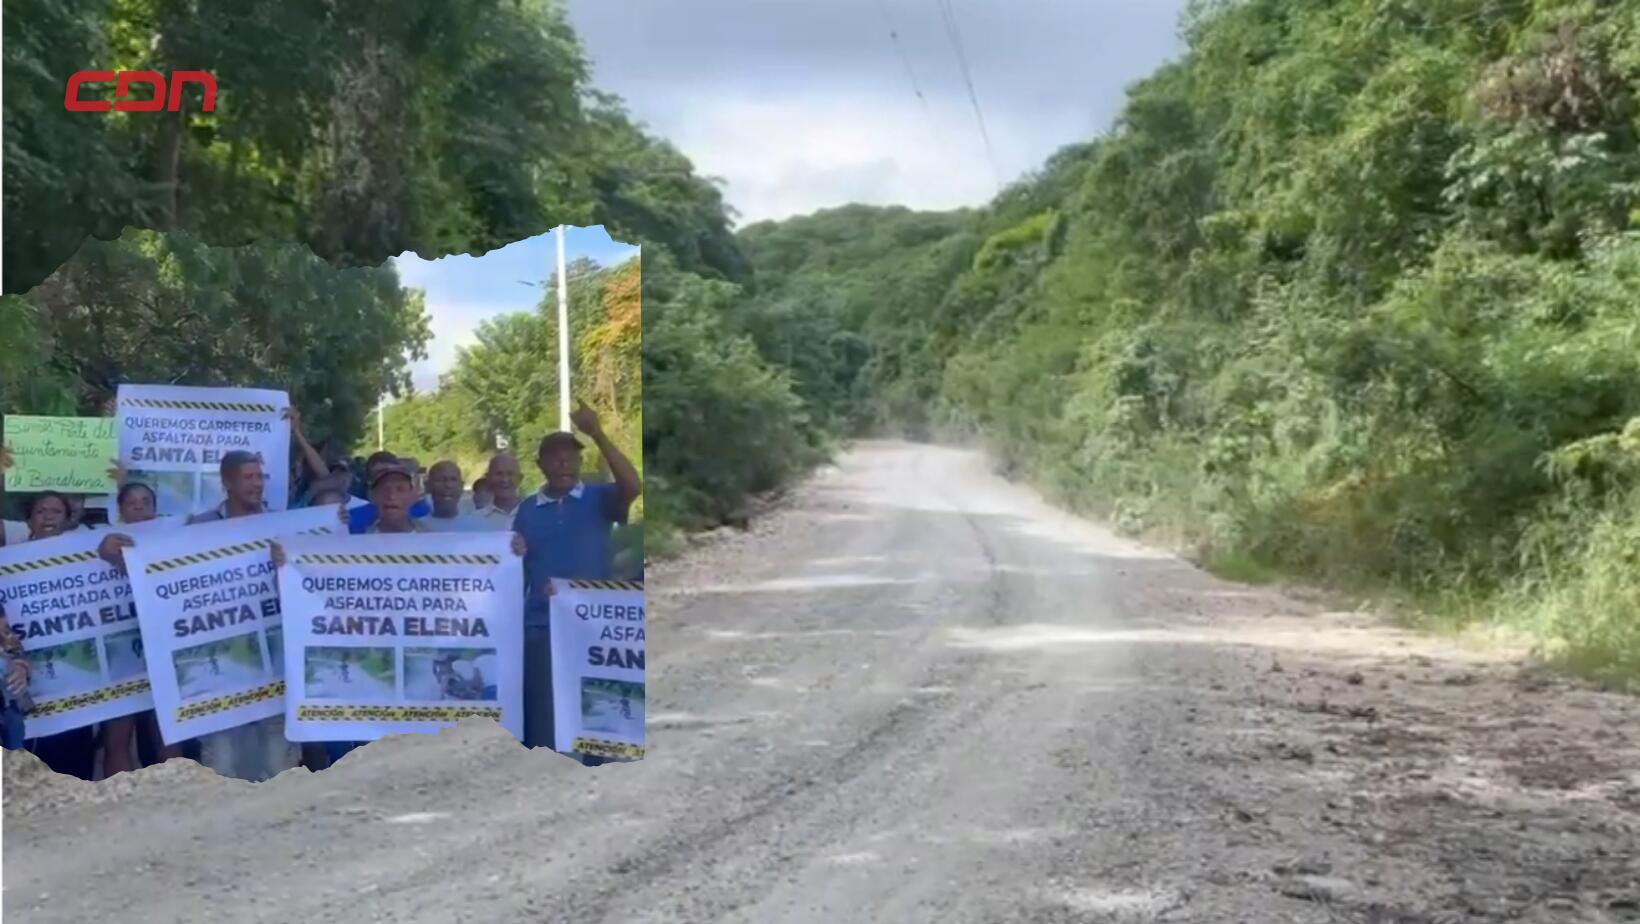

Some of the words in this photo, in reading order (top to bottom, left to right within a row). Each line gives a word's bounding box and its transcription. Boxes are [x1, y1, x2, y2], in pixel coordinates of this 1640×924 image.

[125, 416, 196, 430] QUEREMOS
[198, 419, 271, 433] CARRETERA
[142, 432, 213, 445] ASFALTADA
[216, 434, 250, 446] PARA
[131, 446, 197, 463] SANTA
[155, 568, 244, 600] QUEREMOS
[302, 577, 393, 593] QUEREMOS
[397, 577, 495, 592] CARRETERA
[21, 589, 111, 616] ASFALTADA
[182, 581, 270, 612] ASFALTADA
[324, 597, 418, 611] ASFALTADA
[422, 597, 467, 611] PARA
[11, 610, 95, 641] SANTA
[173, 604, 257, 637] SANTA
[311, 616, 398, 636] SANTA
[403, 616, 490, 637] ELENA
